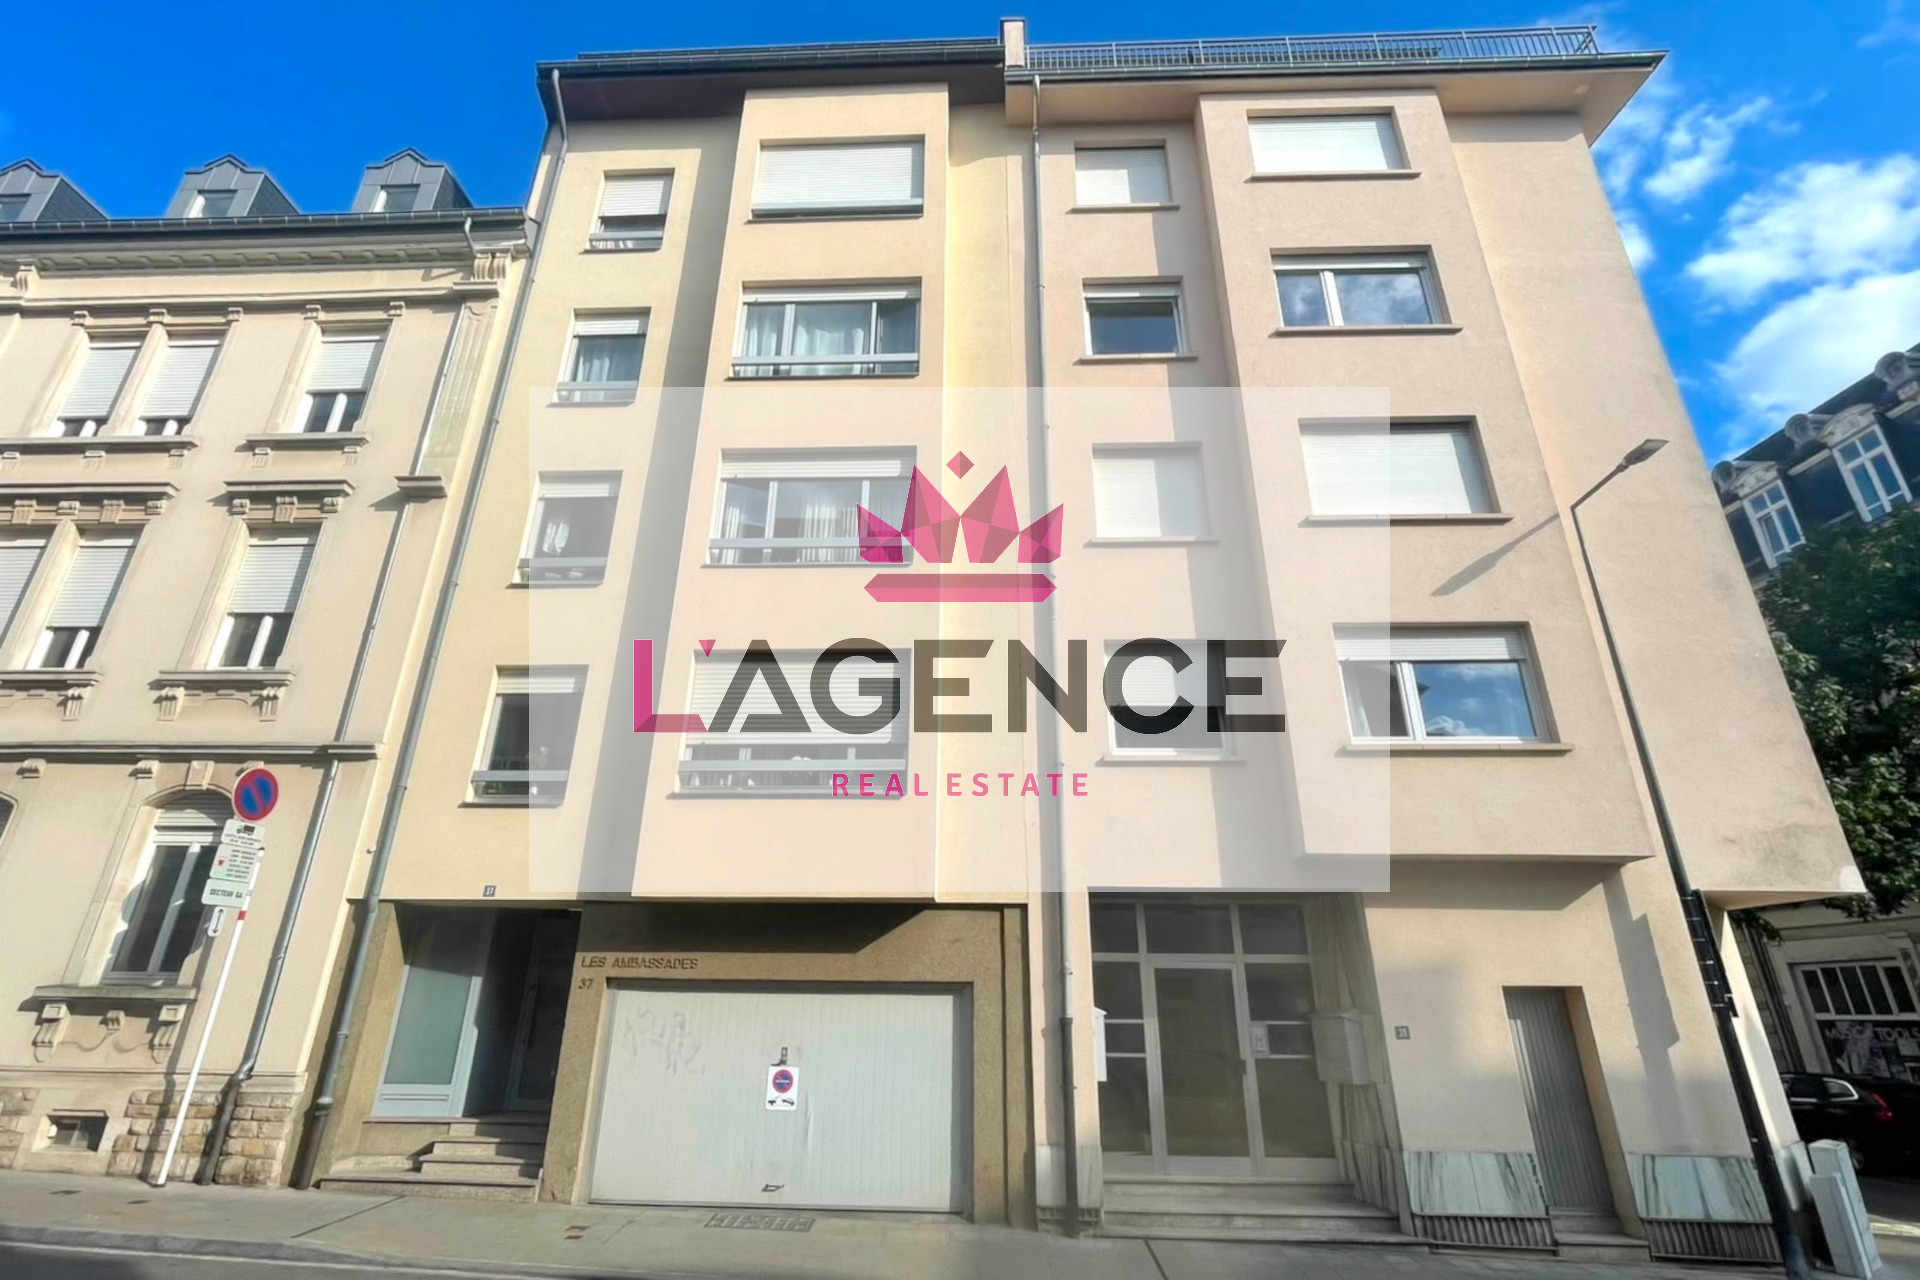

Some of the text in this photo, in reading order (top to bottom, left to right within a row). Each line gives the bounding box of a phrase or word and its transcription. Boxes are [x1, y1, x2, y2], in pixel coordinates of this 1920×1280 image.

[581, 956, 698, 970] LES AMBASSADES
[578, 978, 594, 990] 37
